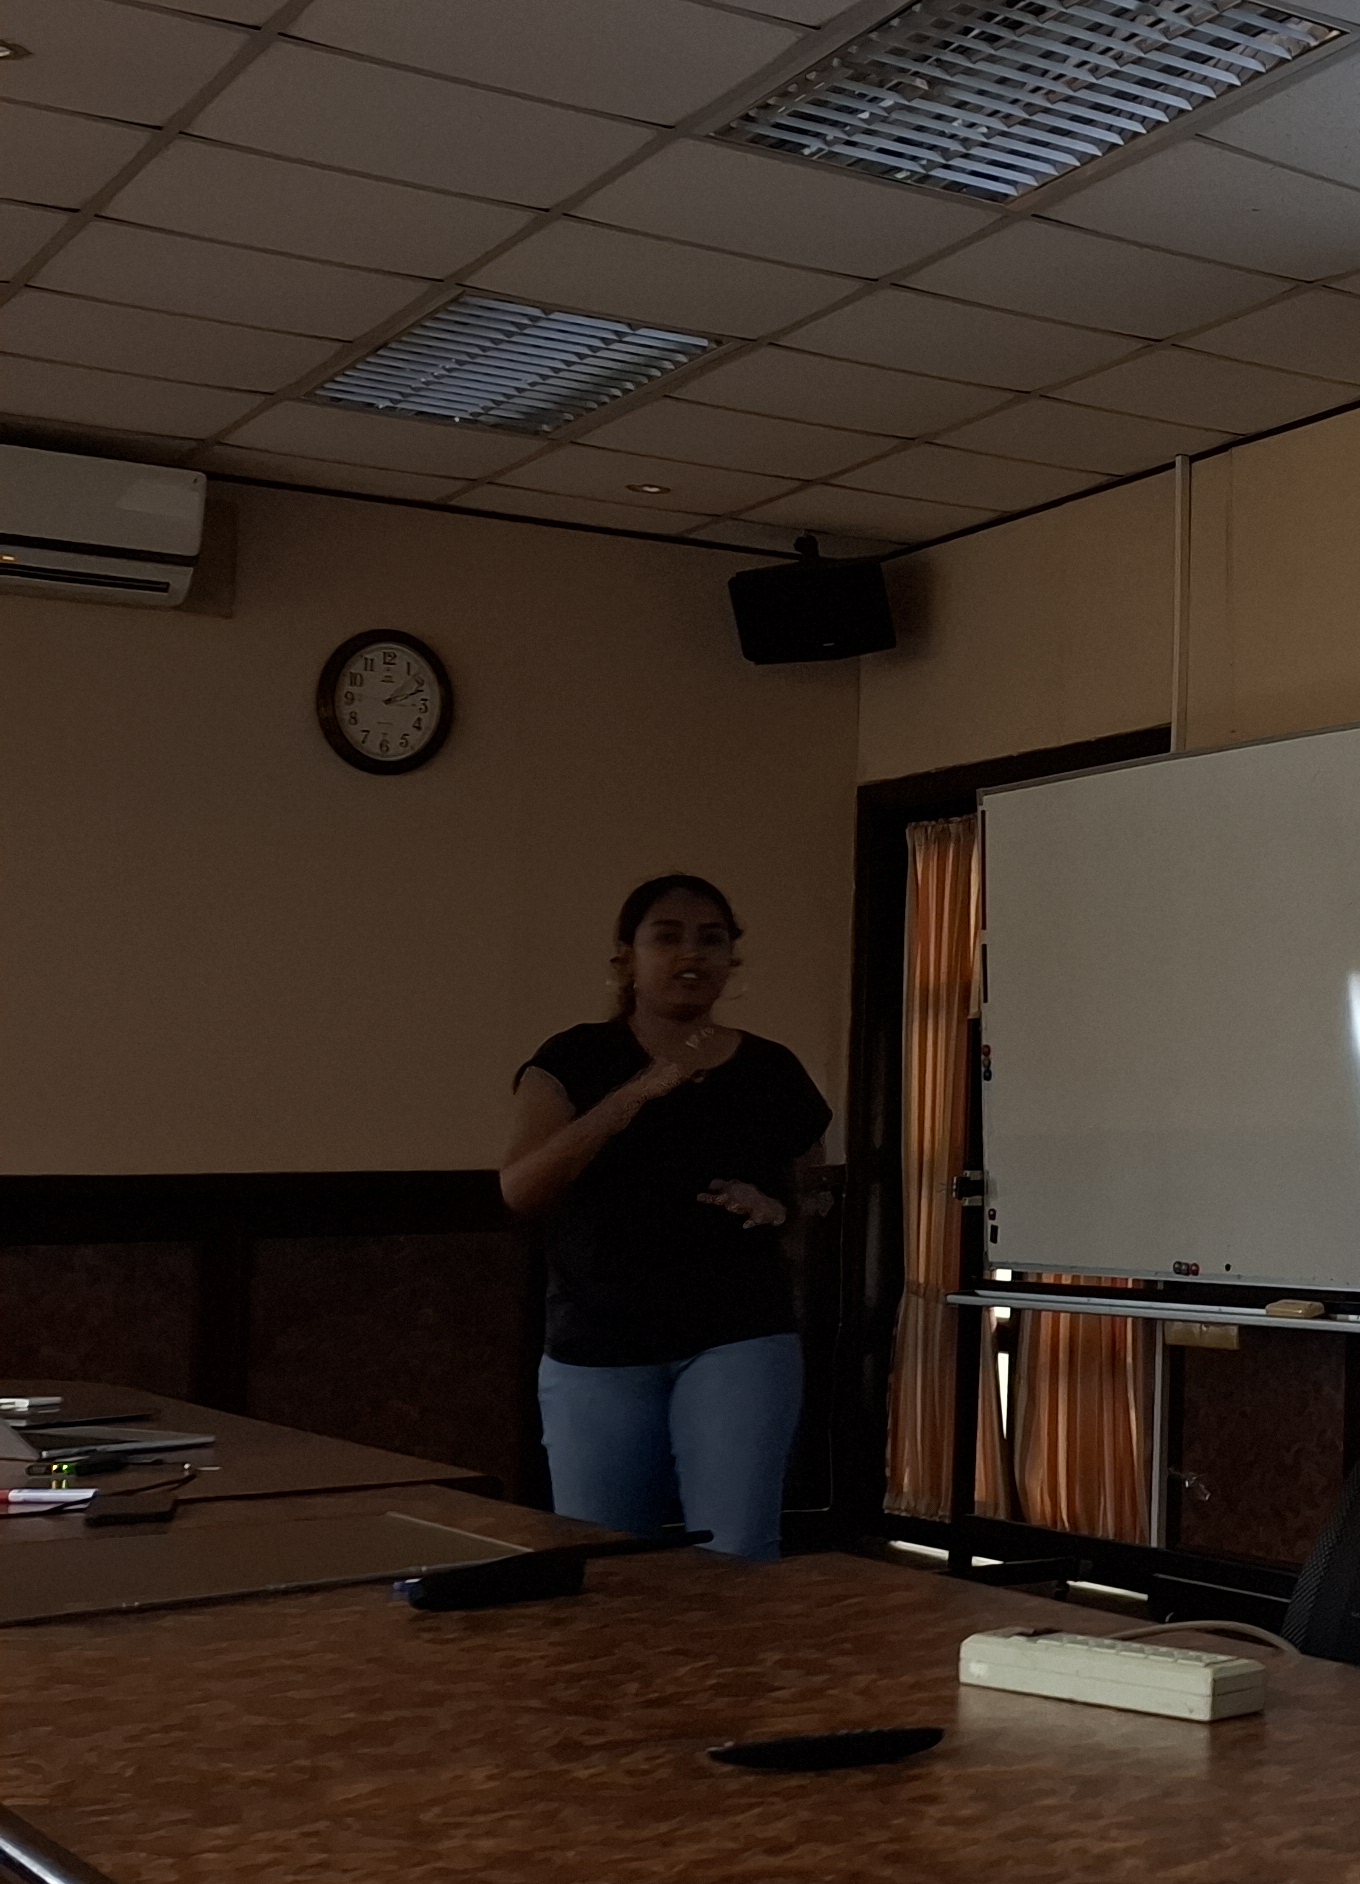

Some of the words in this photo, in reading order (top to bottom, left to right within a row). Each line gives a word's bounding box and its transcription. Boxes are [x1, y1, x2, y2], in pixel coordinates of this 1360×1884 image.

[364, 657, 374, 671] 11
[383, 652, 396, 665] 12
[350, 672, 363, 687] 10
[344, 691, 354, 705] 9
[419, 698, 428, 713] 3
[349, 711, 357, 725] 8
[412, 717, 422, 731] 4
[361, 730, 370, 744] 7
[400, 734, 409, 747] 5
[380, 739, 389, 752] 6
